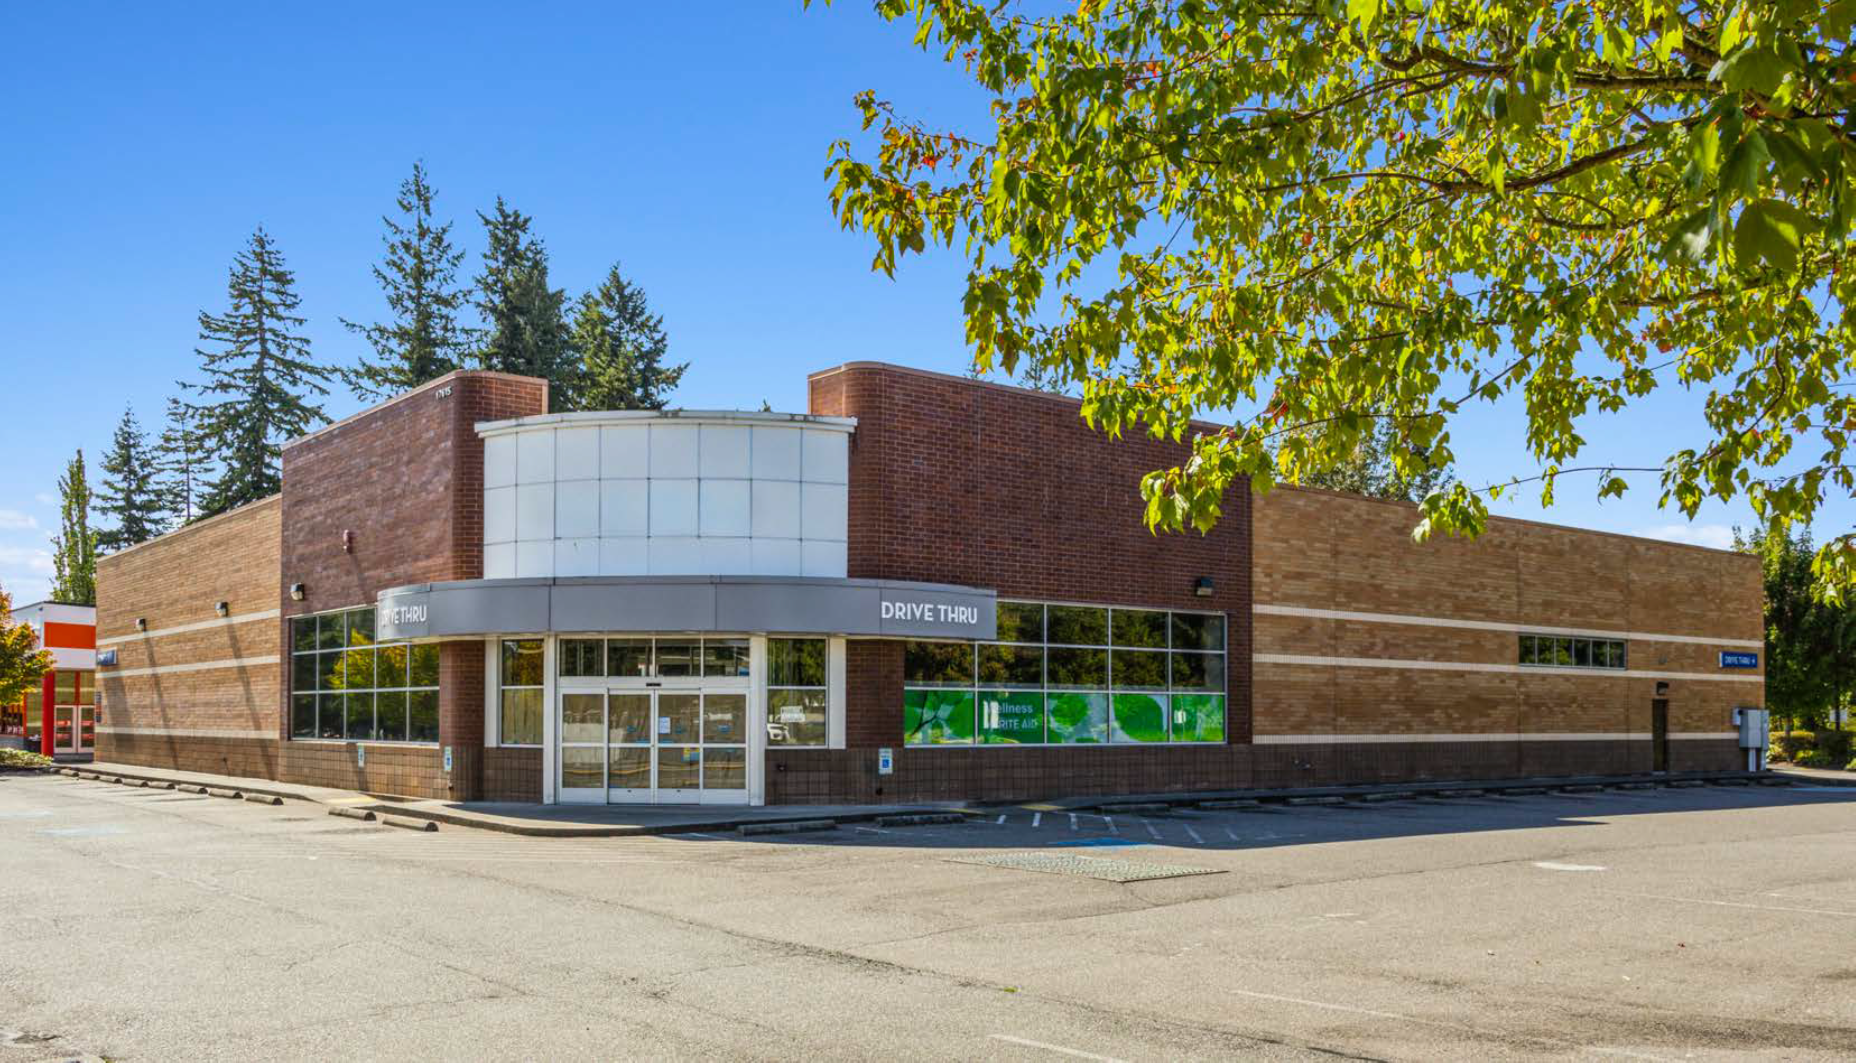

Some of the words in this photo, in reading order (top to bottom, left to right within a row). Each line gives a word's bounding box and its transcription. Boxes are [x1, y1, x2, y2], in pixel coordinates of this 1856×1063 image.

[400, 604, 428, 623] THRU
[881, 601, 934, 621] DRIVE
[937, 604, 978, 624] THRU
